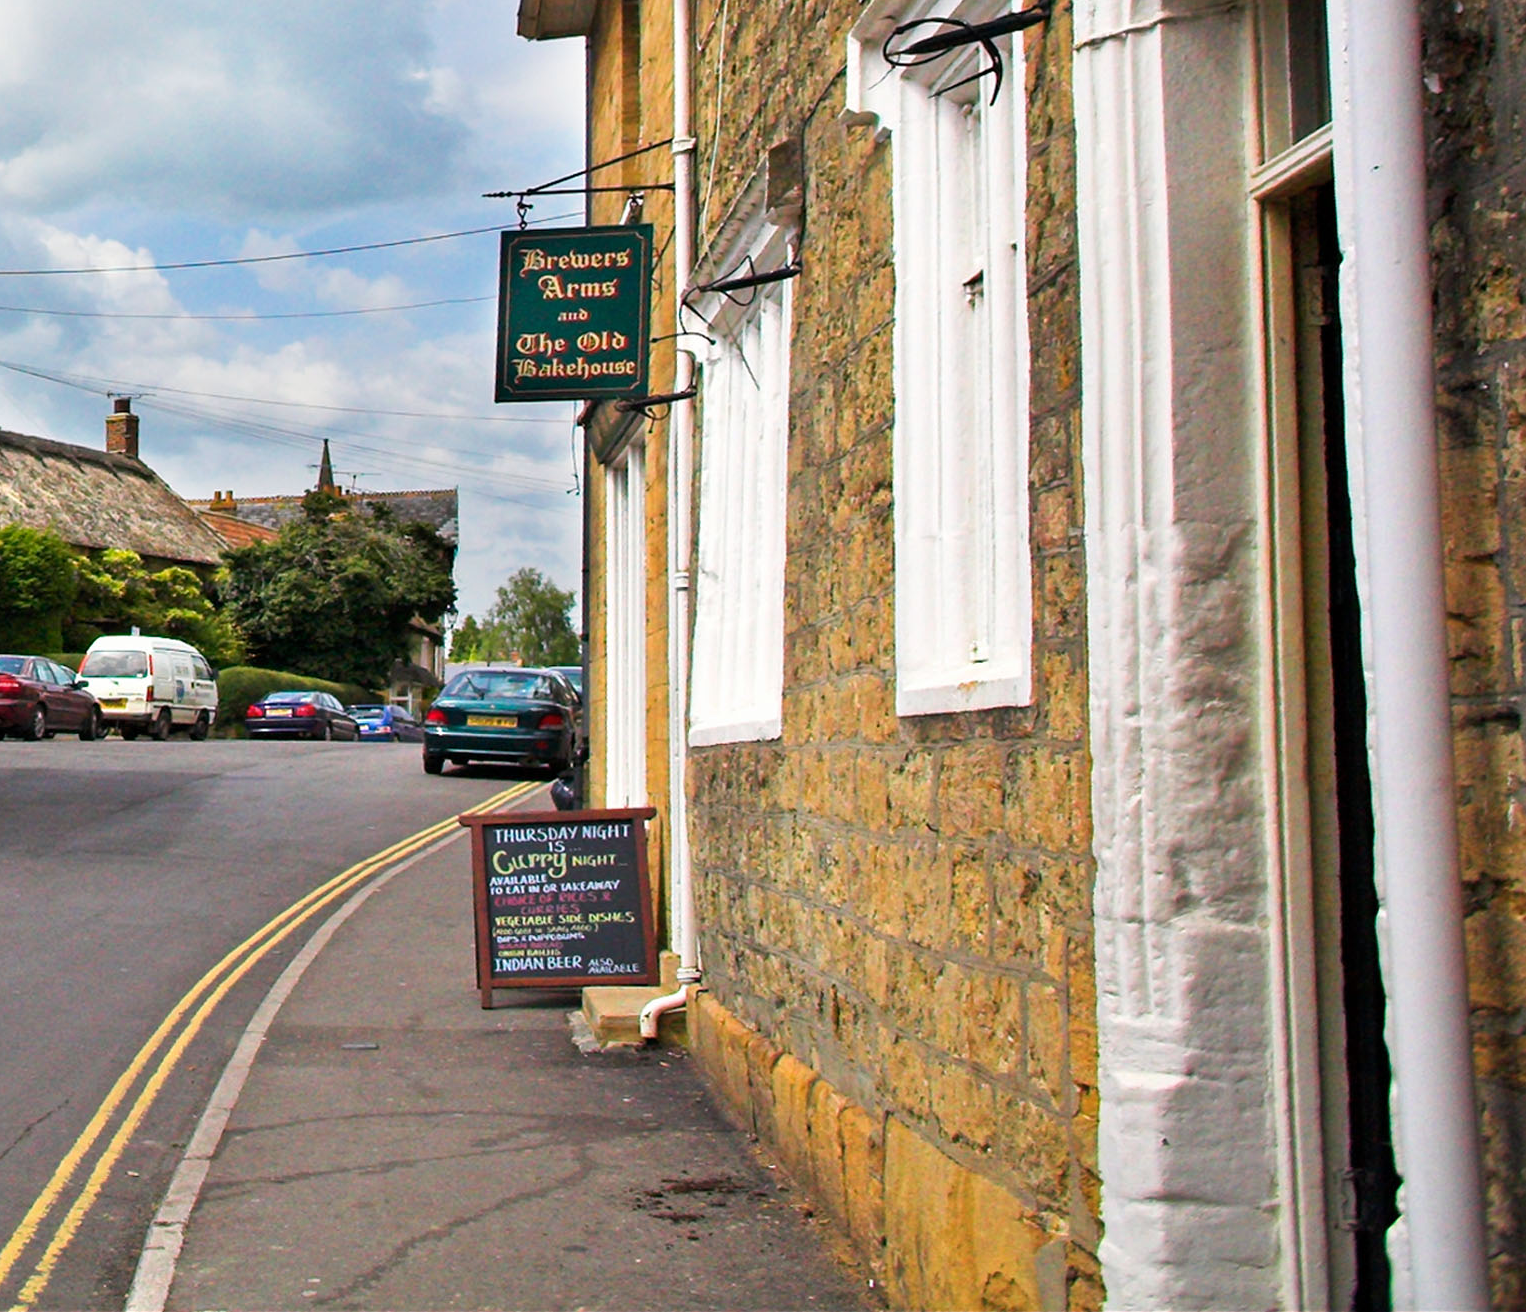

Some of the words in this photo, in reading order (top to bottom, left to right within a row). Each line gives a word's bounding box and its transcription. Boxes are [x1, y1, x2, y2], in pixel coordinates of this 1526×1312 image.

[519, 248, 632, 277] Brewers
[538, 275, 620, 300] Arms
[557, 308, 591, 322] and
[516, 332, 568, 358] The
[577, 331, 629, 351] Old
[511, 357, 636, 384] Bakehouse
[493, 827, 578, 844] THURSDAY
[582, 825, 631, 840] NIGHT
[492, 850, 567, 878] Curry
[489, 874, 548, 886] AVAILABLE
[490, 886, 503, 895] TO
[506, 885, 525, 894] EAT
[528, 885, 540, 894] IN
[543, 883, 558, 893] OR
[561, 879, 621, 892] TAKEAWAY
[520, 903, 581, 915] CURRIES
[495, 915, 554, 927] VEGETABLE
[558, 914, 586, 924] SIDE
[588, 911, 635, 924] DISHES
[494, 957, 544, 972] INDIAN
[547, 955, 583, 969] BEER
[588, 958, 613, 967] ALSO
[588, 963, 640, 974] AVAILABLE
